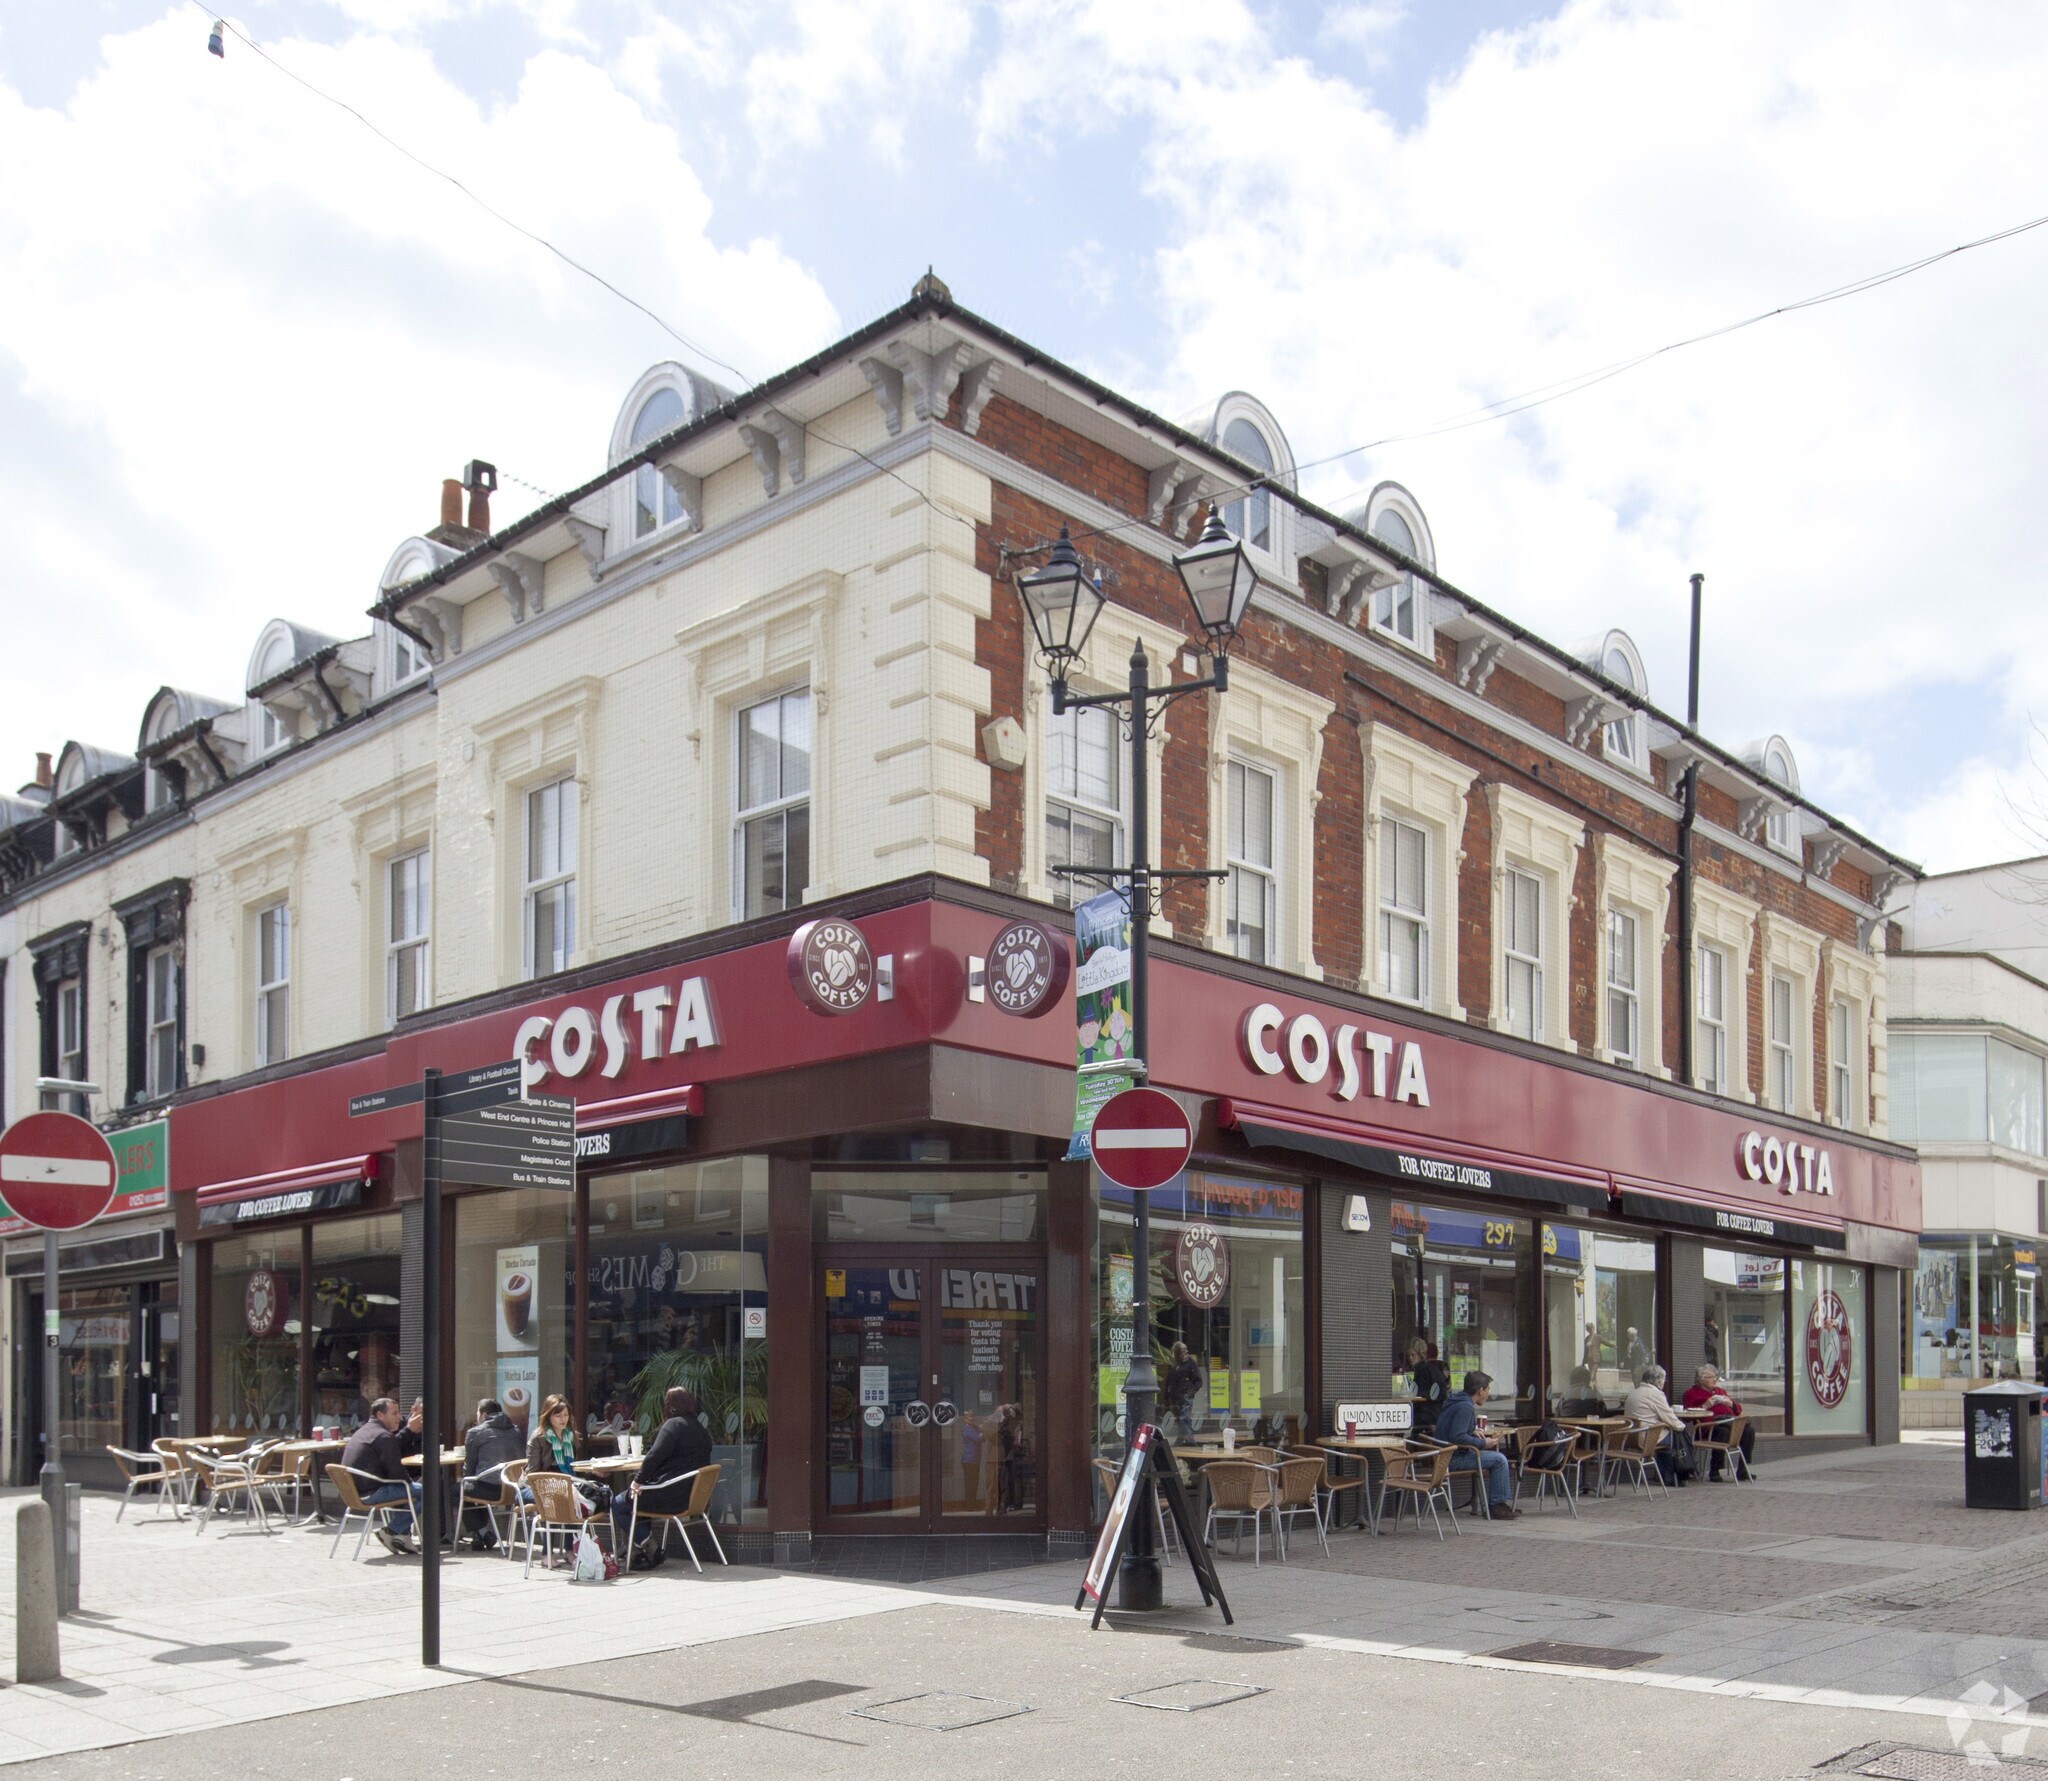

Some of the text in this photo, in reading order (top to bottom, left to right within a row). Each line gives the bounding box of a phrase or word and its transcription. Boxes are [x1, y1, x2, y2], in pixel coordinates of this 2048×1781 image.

[815, 927, 861, 955] COSTA
[998, 929, 1041, 957] COSTA
[812, 971, 867, 1005] COFFEE
[994, 973, 1046, 1006] COFFEE
[513, 976, 719, 1086] COSTA
[1245, 1003, 1430, 1107] COSTA
[468, 1073, 482, 1084] Library
[487, 1067, 503, 1079] Football
[503, 1065, 519, 1075] Ground
[542, 1099, 548, 1107] &
[548, 1100, 571, 1109] Cinema
[480, 1110, 571, 1129] West End Centre & Princes Hall
[532, 1136, 571, 1148] Police Station
[575, 1133, 610, 1158] OVERS
[119, 1141, 154, 1175] LERS
[521, 1154, 571, 1167] Magistrates Court
[1743, 1131, 1833, 1196] COSTA
[513, 1173, 571, 1186] Bus & Train Stations
[1399, 1155, 1491, 1188] FOR COFFEE LOVERS
[238, 1191, 313, 1218] FOR COFFEE LOVERS
[1134, 1218, 1139, 1227] 1
[1716, 1211, 1774, 1236] FOR COFFEE LOVERS
[1185, 1226, 1218, 1250] COSTA
[251, 1274, 271, 1293] COSTA
[1184, 1270, 1223, 1300] COFFEE
[248, 1309, 273, 1330] COFFEE
[968, 1320, 1003, 1330] Thank you
[1814, 1300, 1843, 1330] COSTA
[50, 1336, 58, 1346] 3
[970, 1328, 1001, 1338] for voting
[971, 1337, 1000, 1345] Costa the
[972, 1345, 998, 1354] nation's
[972, 1354, 1000, 1363] favourite
[505, 1371, 536, 1381] Mocha Latte
[968, 1363, 1003, 1373] coffee shop
[1812, 1360, 1847, 1401] COFFEE
[1343, 1410, 1407, 1424] UNION STREET
